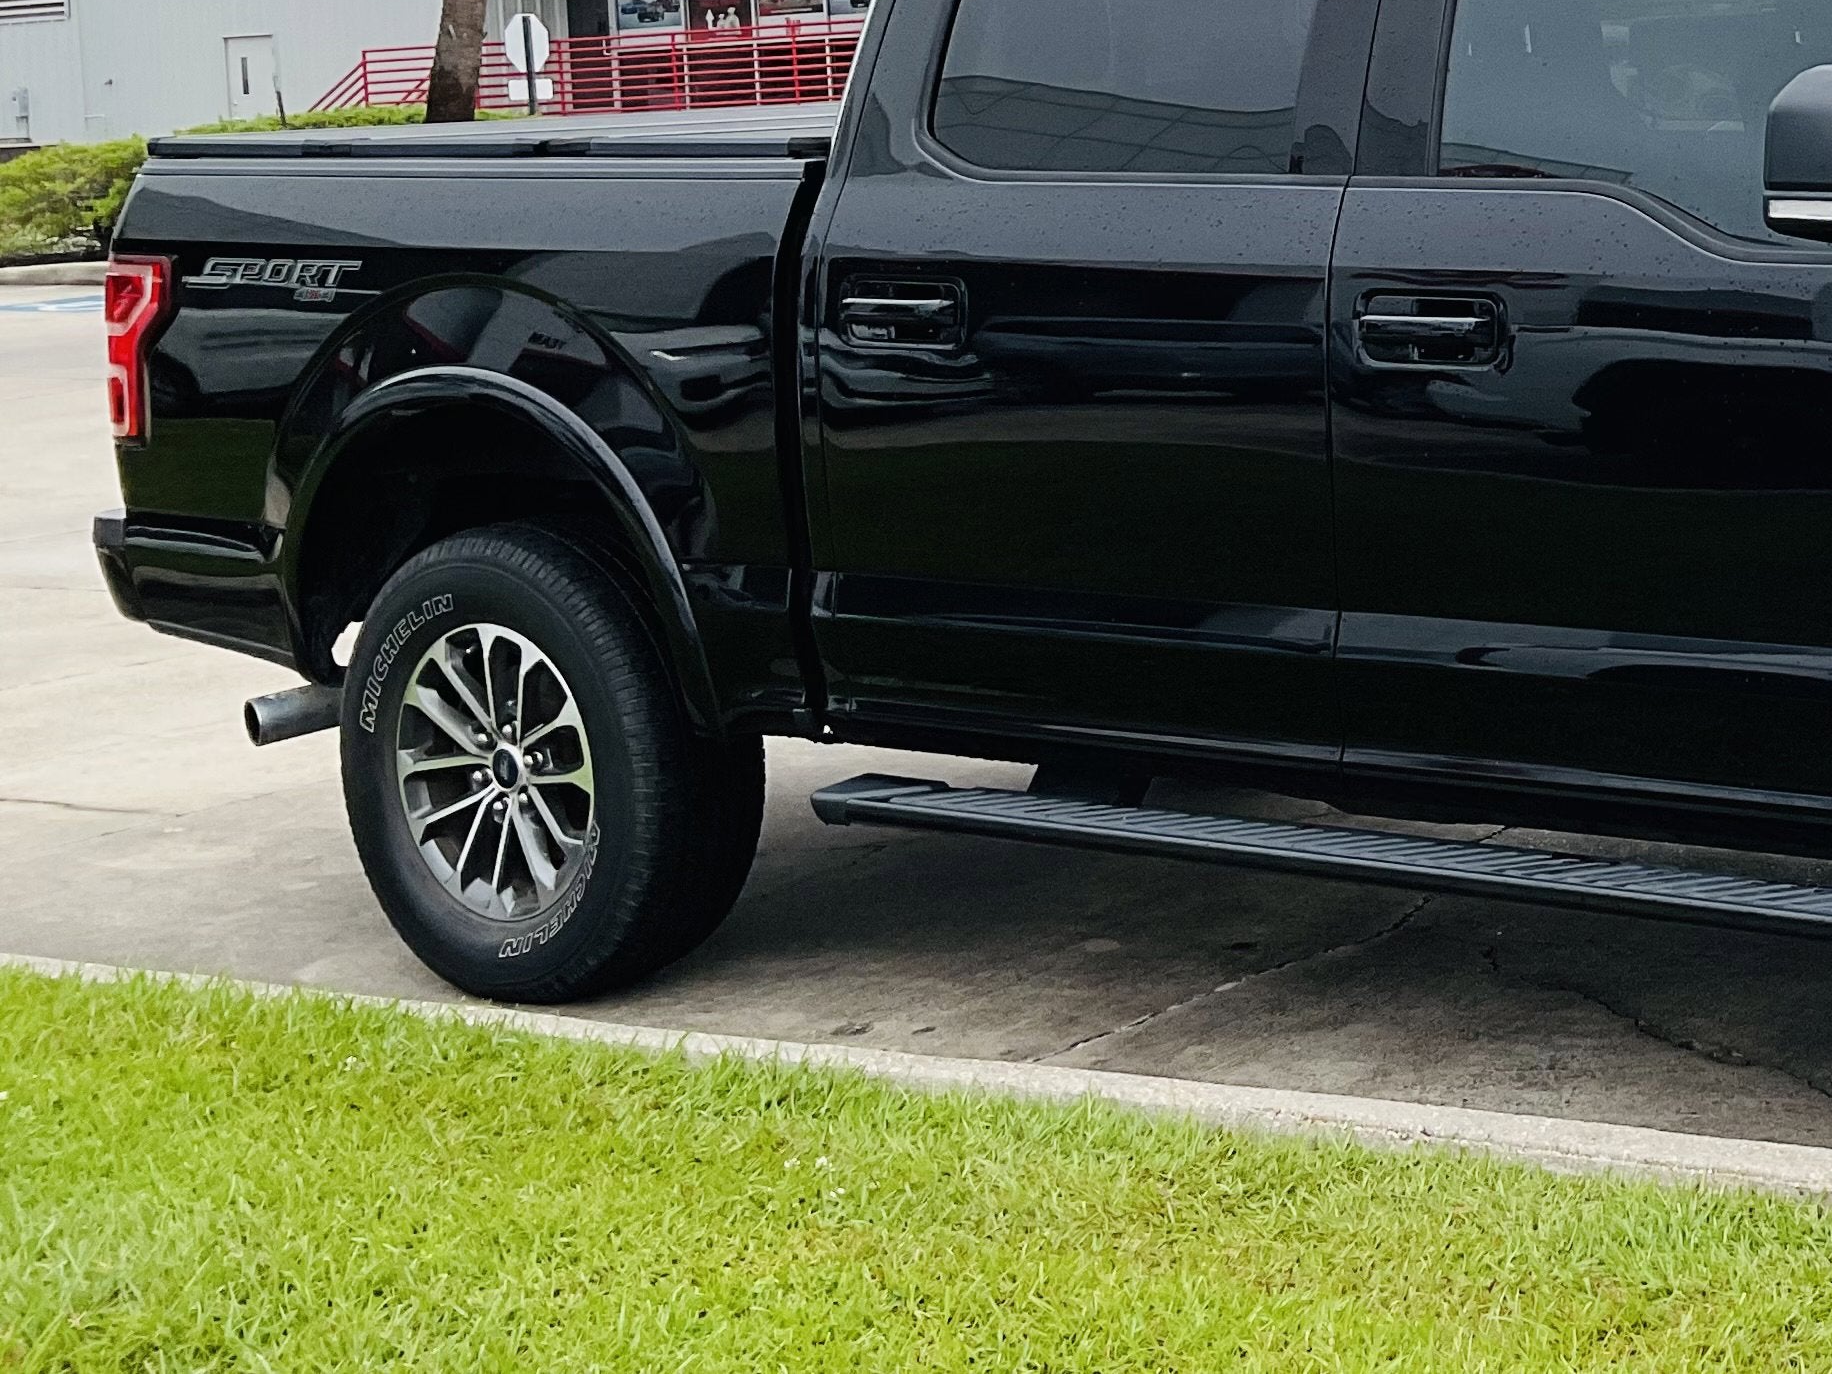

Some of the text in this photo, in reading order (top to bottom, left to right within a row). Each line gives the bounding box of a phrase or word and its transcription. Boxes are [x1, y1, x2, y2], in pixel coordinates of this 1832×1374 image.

[181, 257, 363, 289] SPORT
[360, 594, 454, 733] MICHELIN
[499, 822, 601, 957] MICHELIN
